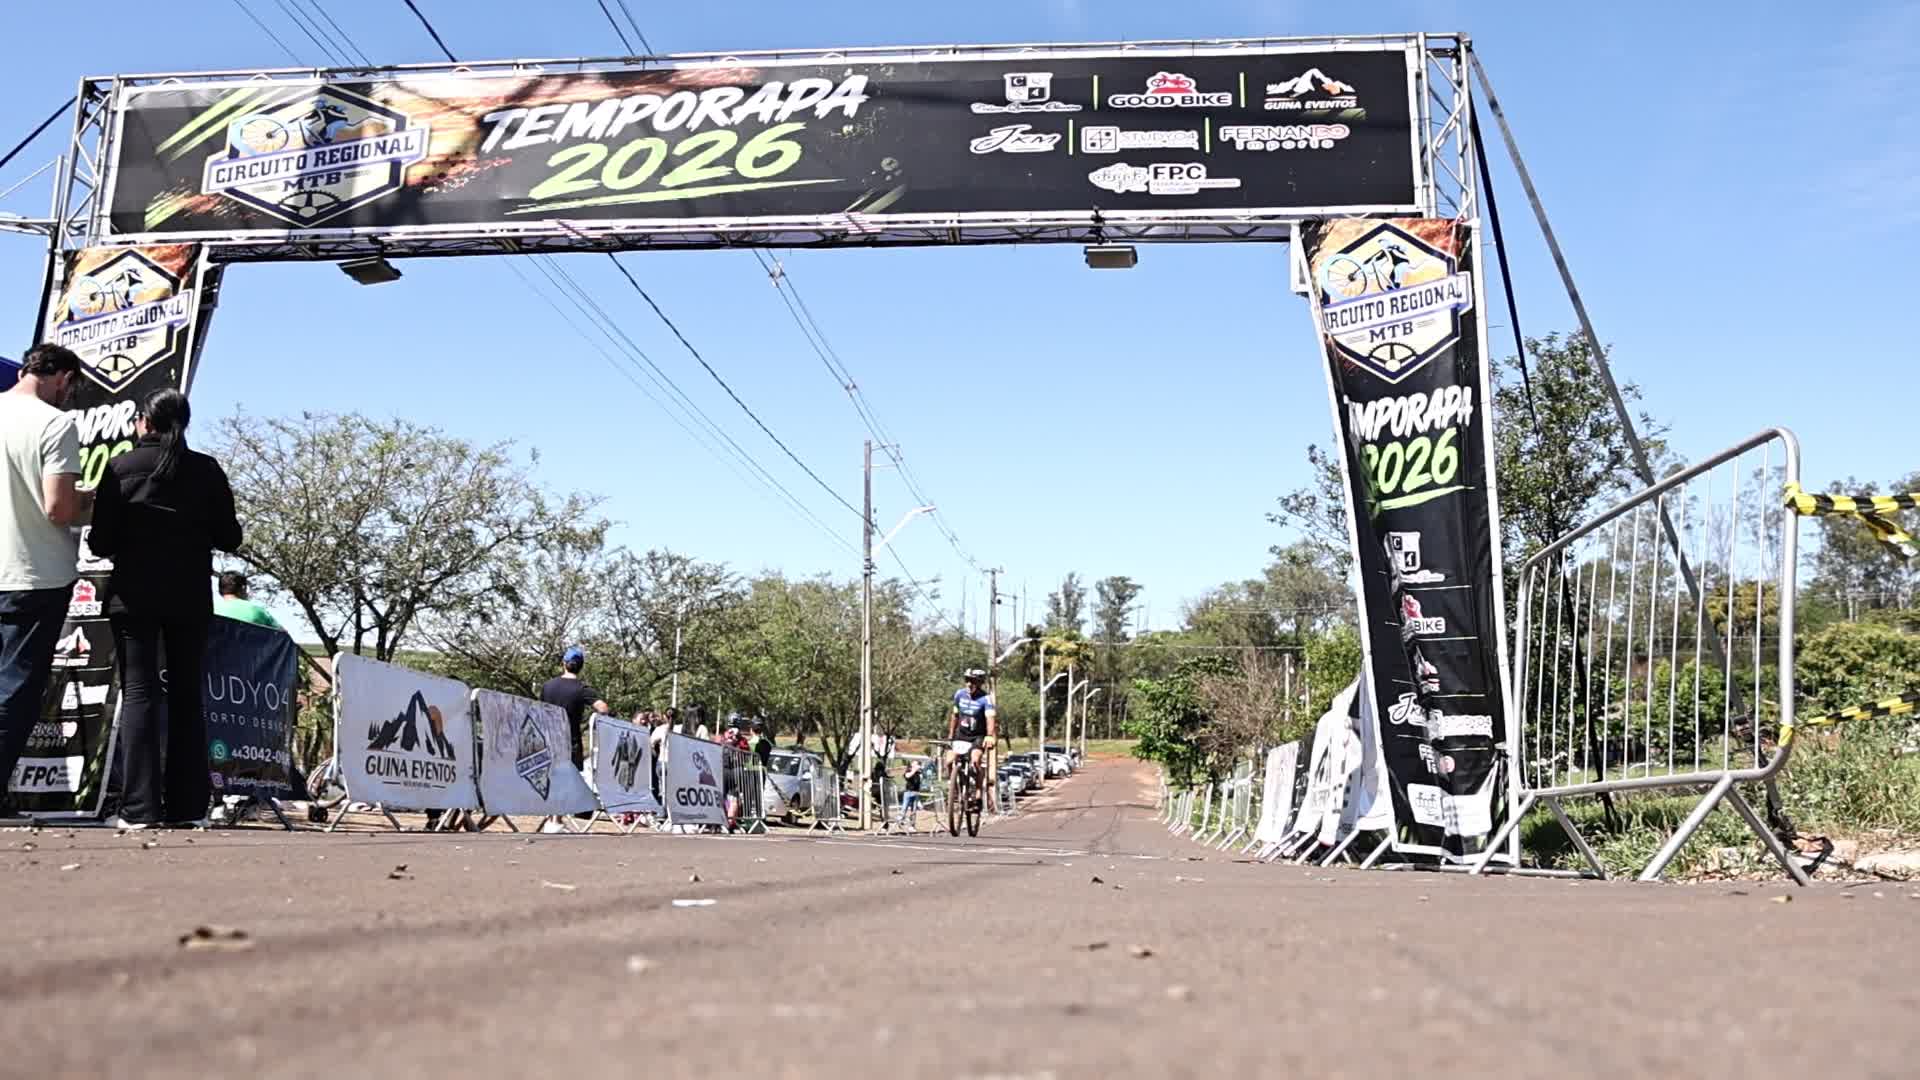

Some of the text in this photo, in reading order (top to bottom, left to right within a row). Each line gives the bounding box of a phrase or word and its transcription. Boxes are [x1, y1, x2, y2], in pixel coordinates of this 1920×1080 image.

[1111, 94, 1229, 106] GOOD BIKE
[1264, 100, 1357, 110] GUINA EVENTOS
[1221, 126, 1348, 140] FERNANDO
[215, 135, 415, 184] CIRCUITO REGIONAL
[528, 122, 806, 201] 2026
[283, 172, 341, 192] MTB
[1325, 282, 1463, 329] IRCUITO REGIONAL
[61, 300, 183, 346] CIRCUITO REGIONAL
[1369, 322, 1414, 343] MTB
[100, 335, 138, 355] MTB
[1414, 619, 1443, 631] BIKE
[20, 766, 58, 786] FPC
[365, 755, 457, 783] GUINA EVENTOS
[676, 788, 714, 807] GOOD
